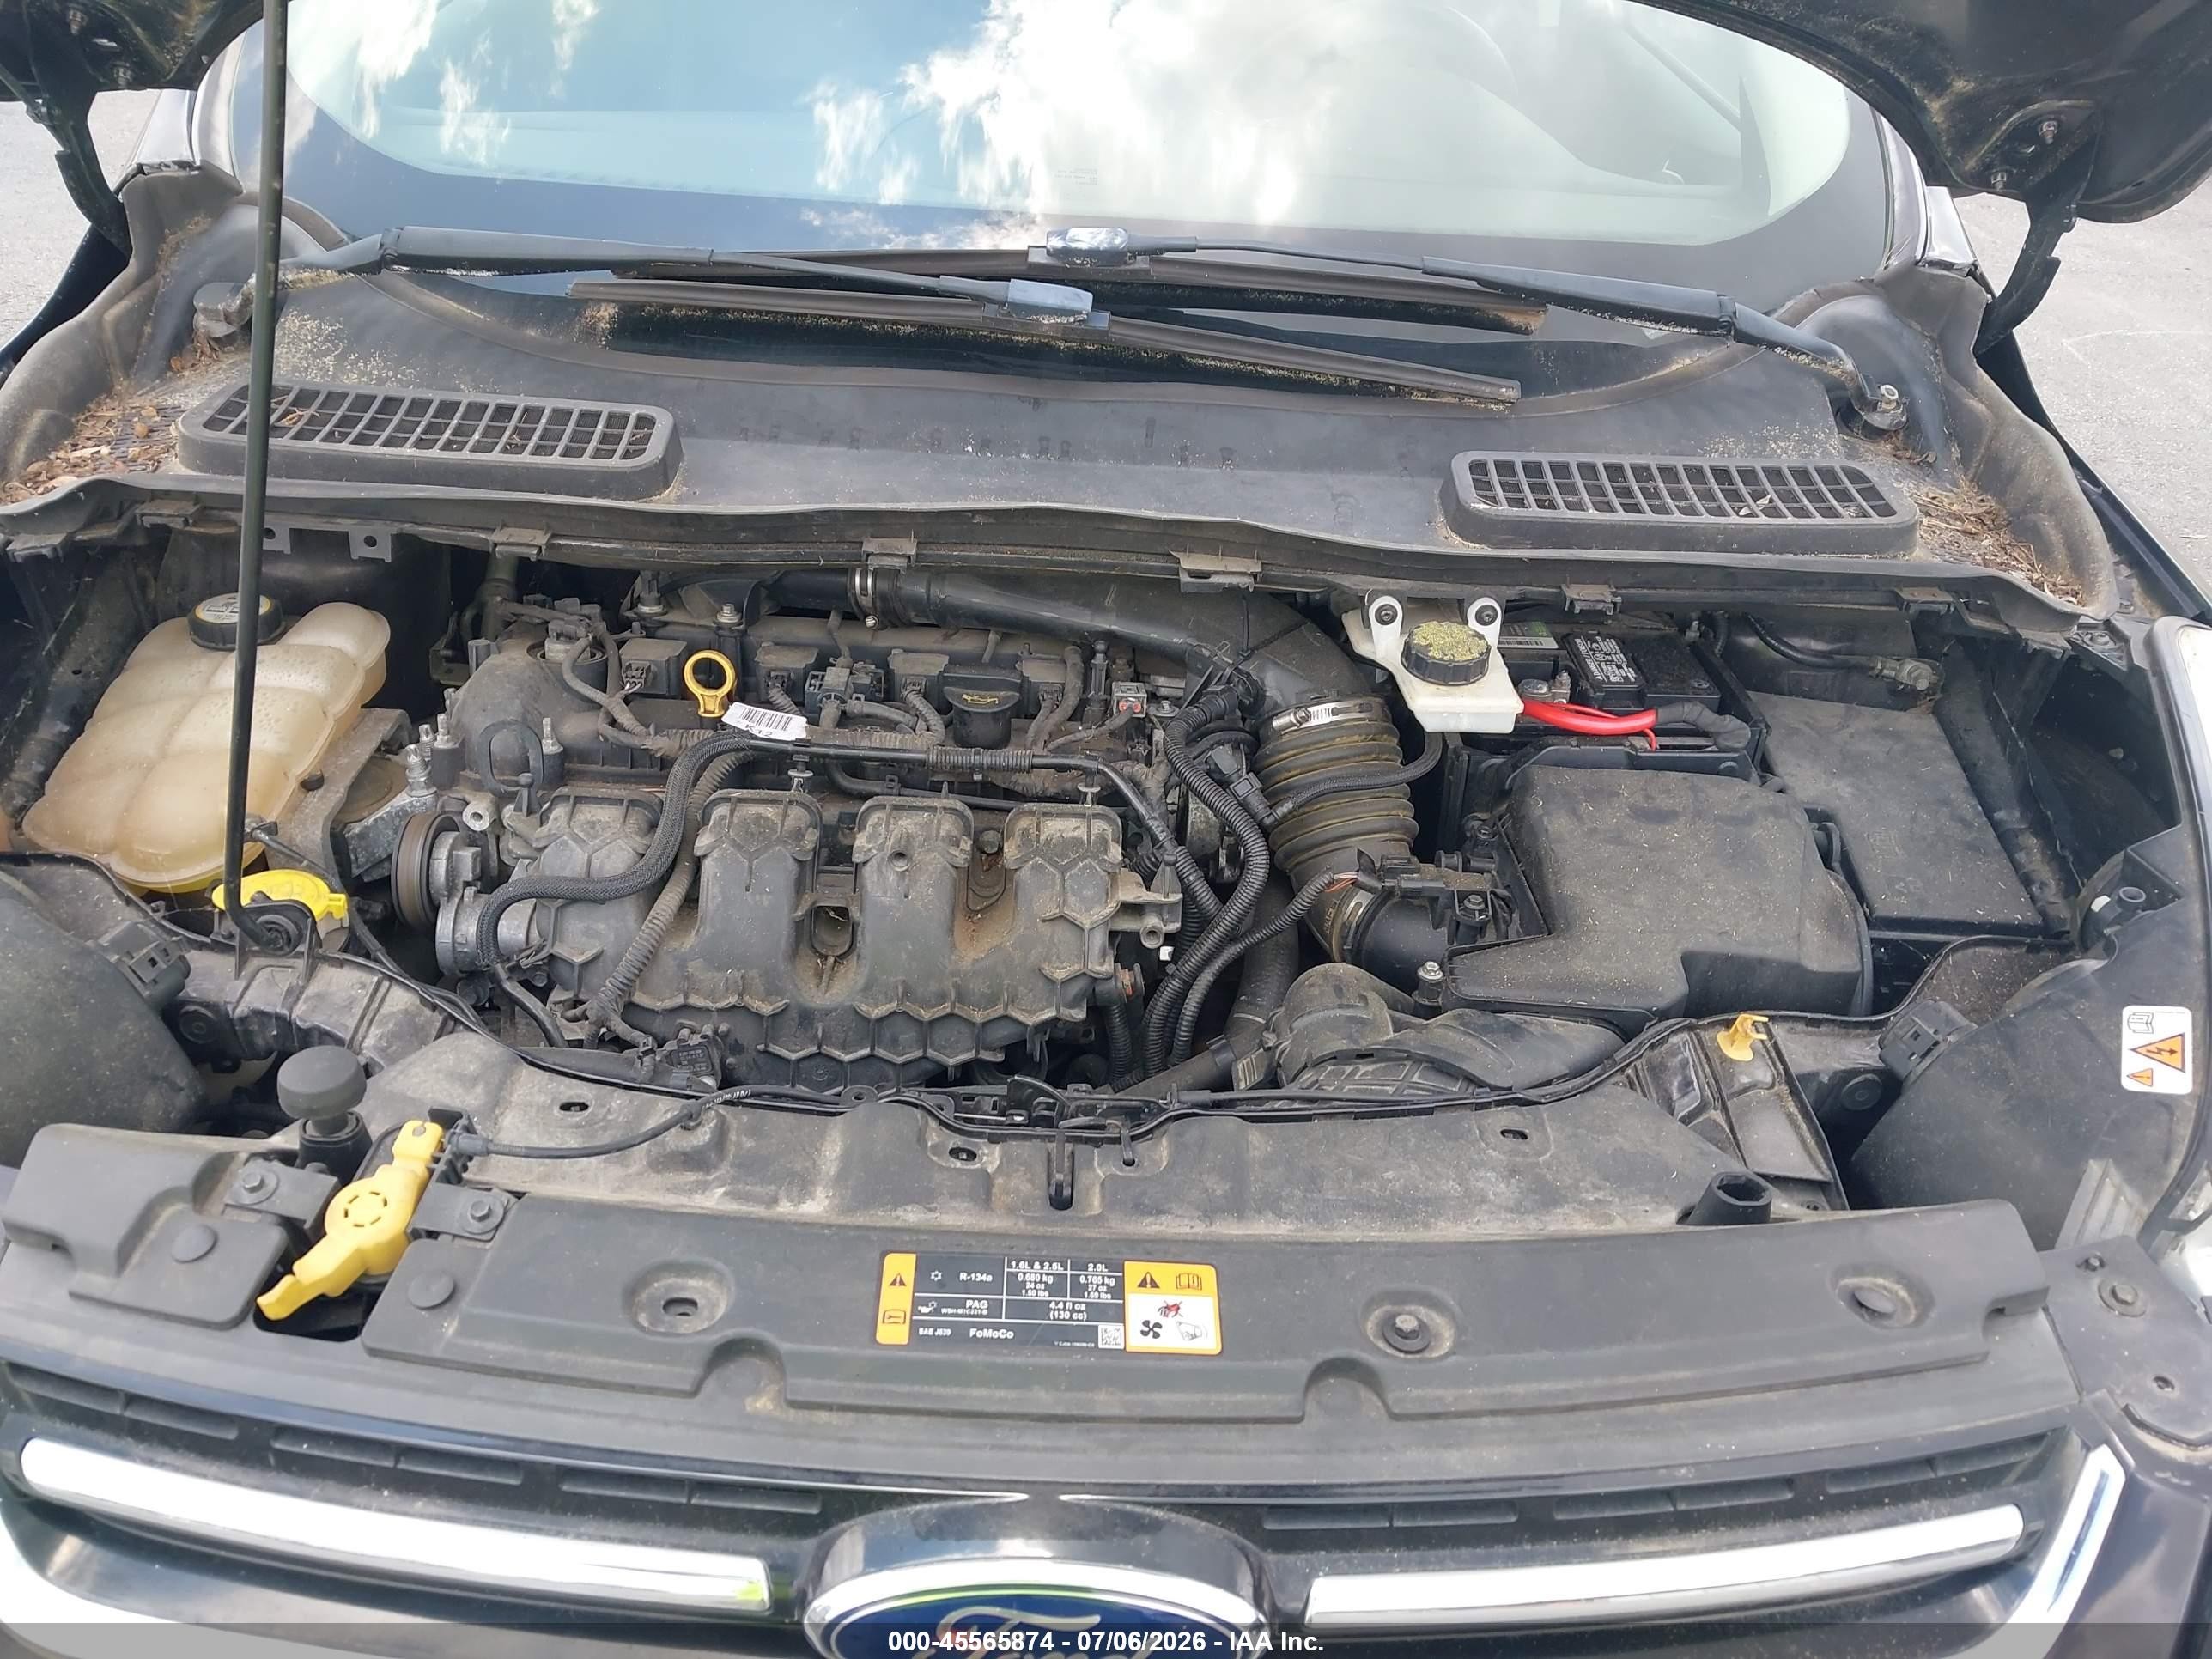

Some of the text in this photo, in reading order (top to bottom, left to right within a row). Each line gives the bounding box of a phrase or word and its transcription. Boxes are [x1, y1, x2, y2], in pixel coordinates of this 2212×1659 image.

[1011, 1261, 1030, 1270] 1.6L
[1033, 1261, 1041, 1270] &
[1087, 1263, 1109, 1272] 2.0L
[959, 1272, 993, 1282] R-134a
[1018, 1273, 1054, 1285] 0.680 kg
[1079, 1275, 1115, 1287] 0.765 kg
[965, 1299, 988, 1309] PAG
[1049, 1301, 1064, 1310] 4.4
[1066, 1301, 1073, 1310] fl
[1049, 1310, 1087, 1322] (130 cc)
[918, 1328, 934, 1336] SAE
[969, 1328, 1014, 1340] FoMoCo
